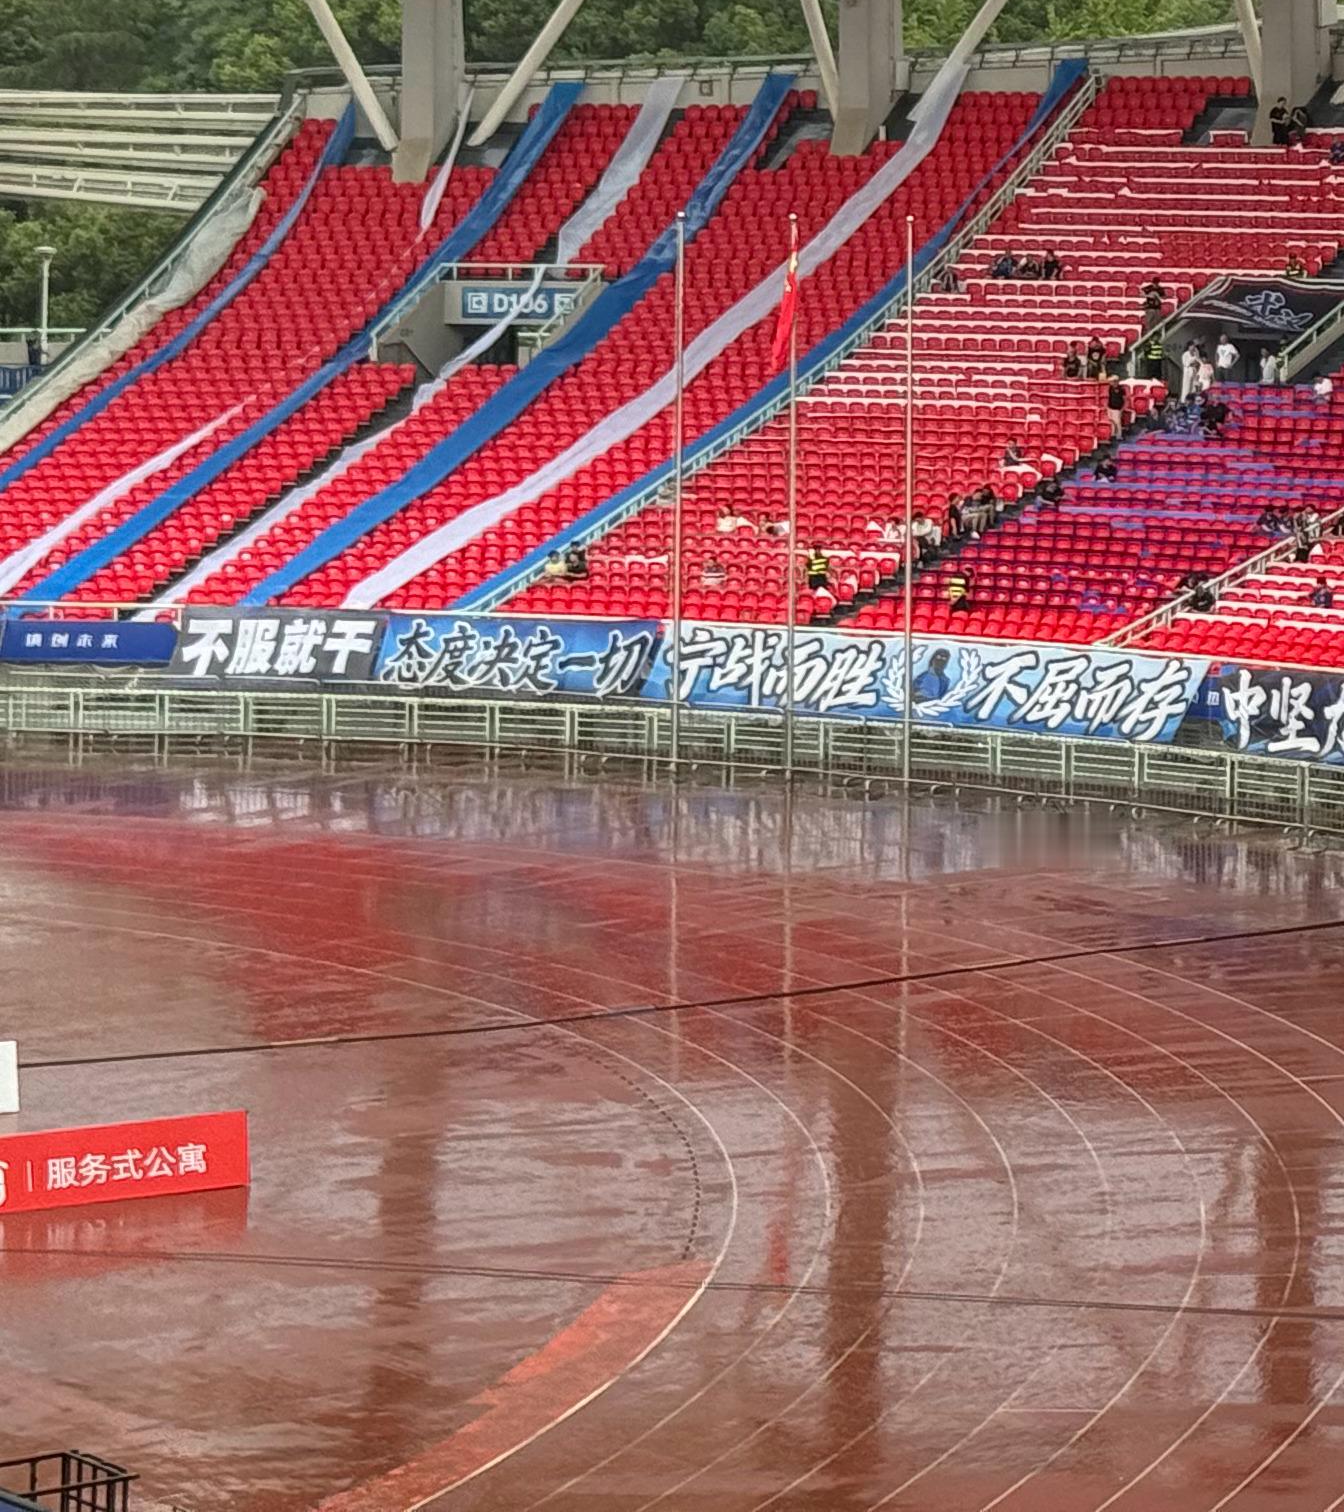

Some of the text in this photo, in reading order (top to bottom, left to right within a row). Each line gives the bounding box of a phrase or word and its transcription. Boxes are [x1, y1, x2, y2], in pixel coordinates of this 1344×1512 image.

[181, 618, 376, 678] 不服就干
[380, 618, 652, 699] 态度决定一切
[964, 649, 1193, 742] 不屈而存
[46, 1142, 207, 1190] 服务式公寓
